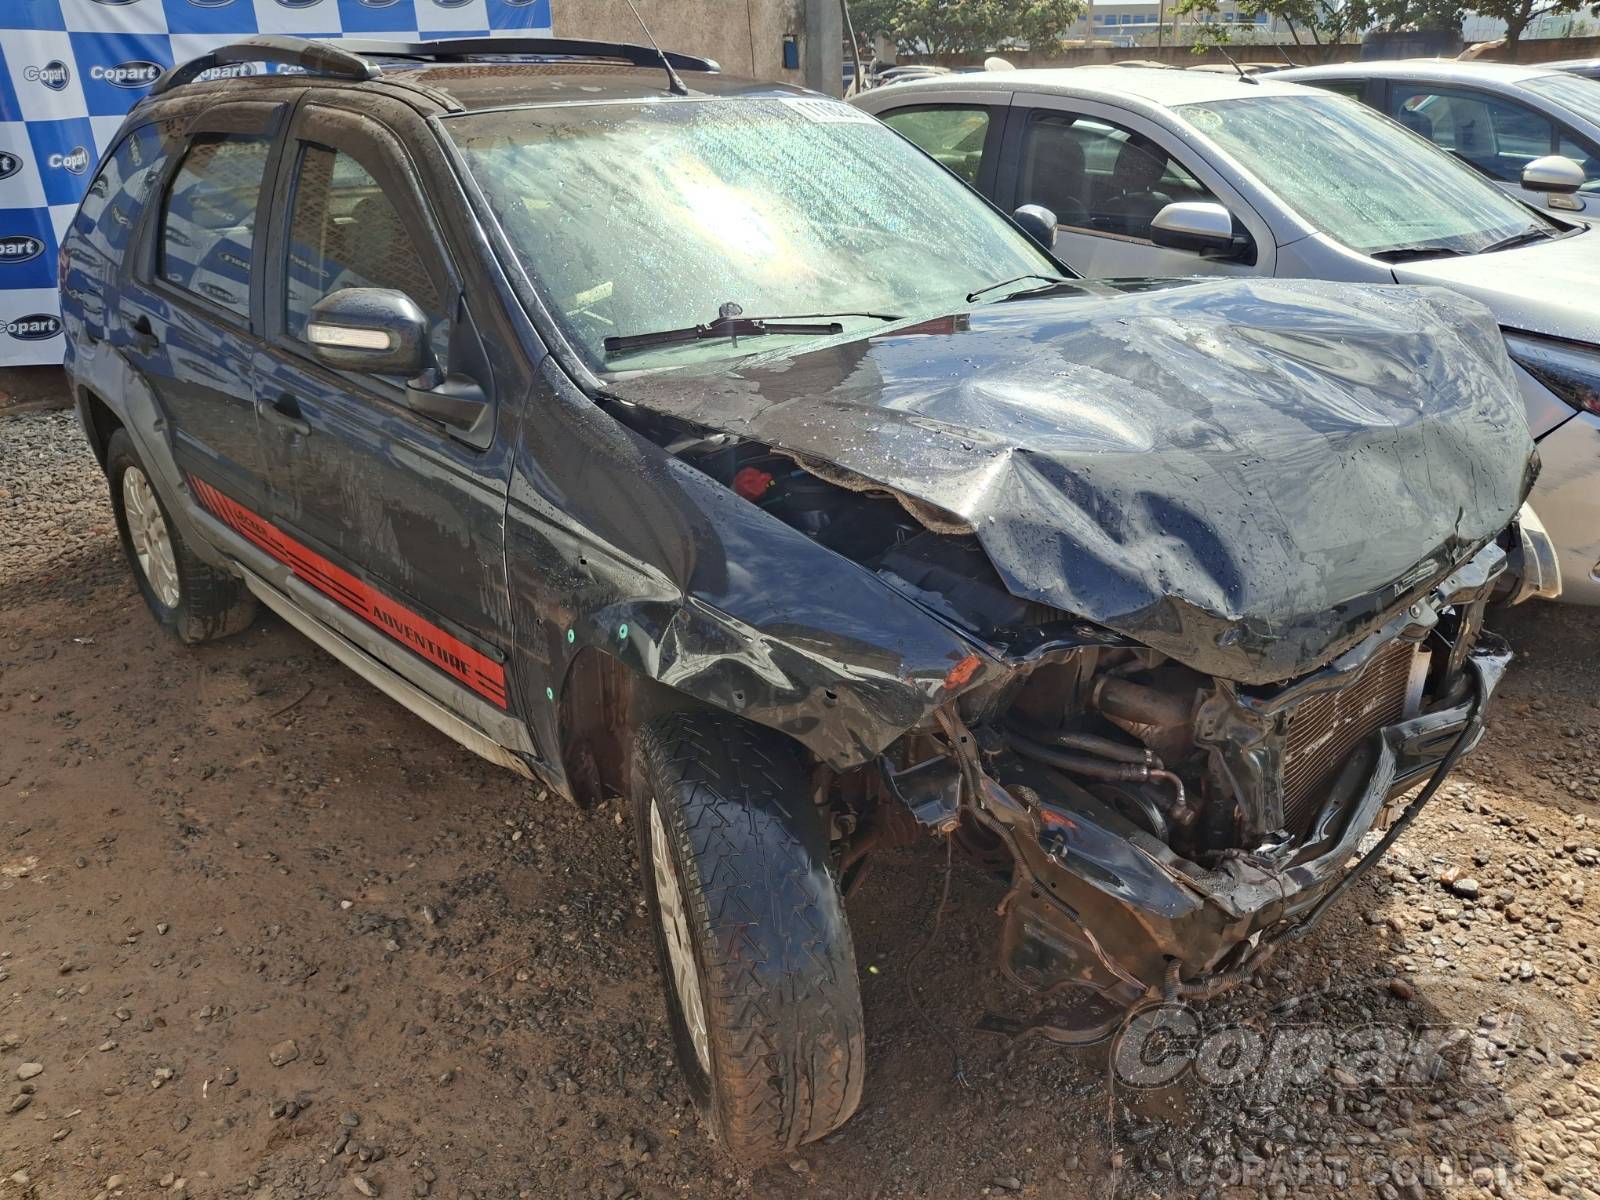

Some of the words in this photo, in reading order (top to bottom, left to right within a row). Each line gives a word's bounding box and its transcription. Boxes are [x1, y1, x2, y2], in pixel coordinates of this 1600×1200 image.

[24, 65, 67, 81] Copart
[90, 65, 156, 81] Copart
[49, 153, 87, 170] Copart
[373, 606, 471, 675] ADVENTURE
